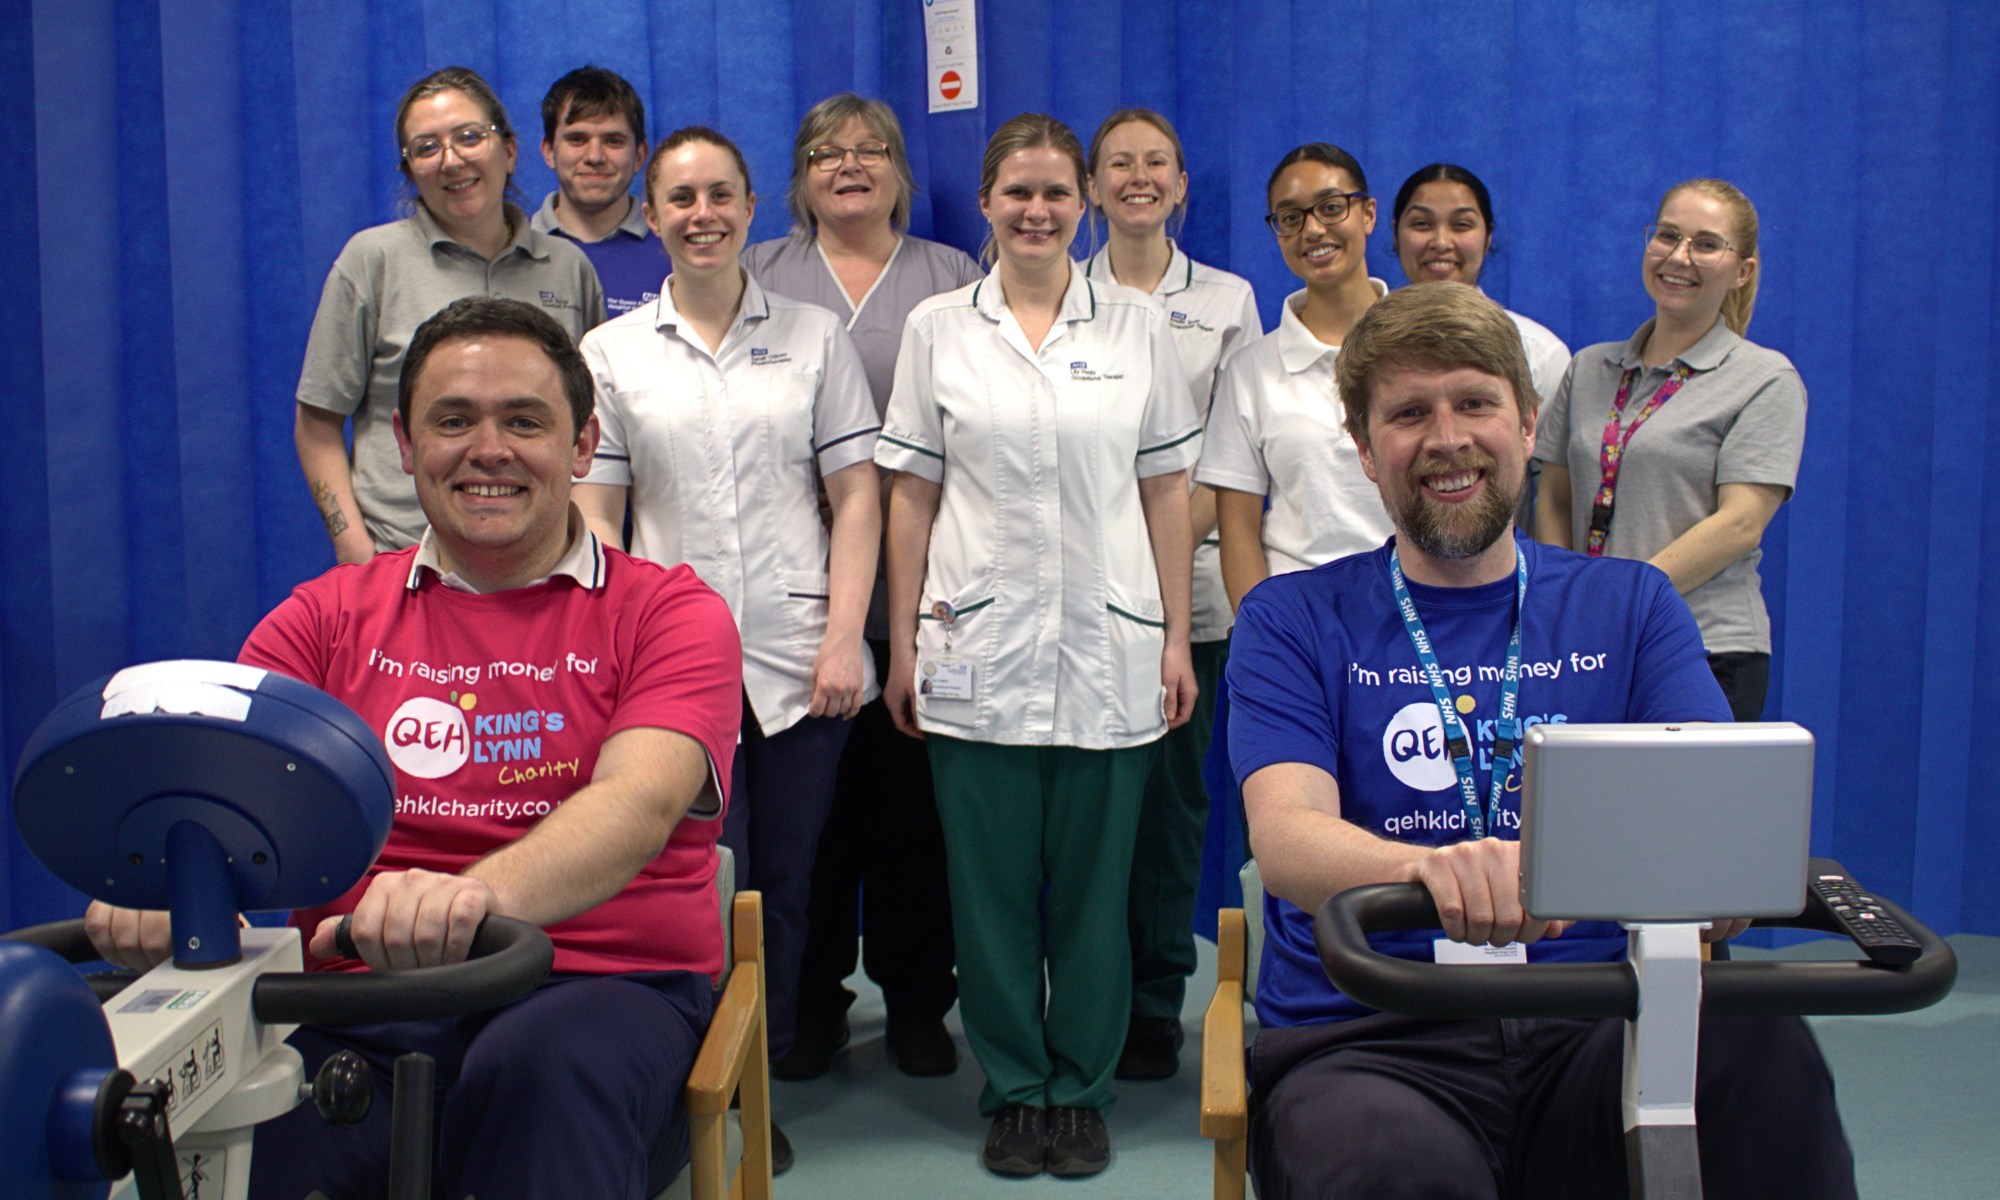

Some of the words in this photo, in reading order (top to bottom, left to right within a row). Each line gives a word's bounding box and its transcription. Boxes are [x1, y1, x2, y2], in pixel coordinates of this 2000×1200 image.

[1392, 567, 1404, 591] NHS
[1400, 597, 1418, 622] NHS
[1412, 629, 1431, 654] NHS
[368, 648, 405, 677] I'm
[408, 661, 481, 685] raising
[565, 652, 598, 674] for
[1387, 665, 1472, 686] raisng
[1570, 652, 1607, 673] for
[1425, 662, 1445, 688] NHS
[1506, 655, 1518, 682] NHS
[1439, 697, 1457, 725] NHS
[1502, 691, 1516, 720] NHS
[391, 717, 466, 756] QEH
[473, 709, 565, 737] KING'S
[473, 737, 541, 763] LYNN
[498, 758, 580, 785] Charity
[1461, 776, 1478, 806] NHS
[1491, 781, 1503, 812] NHS
